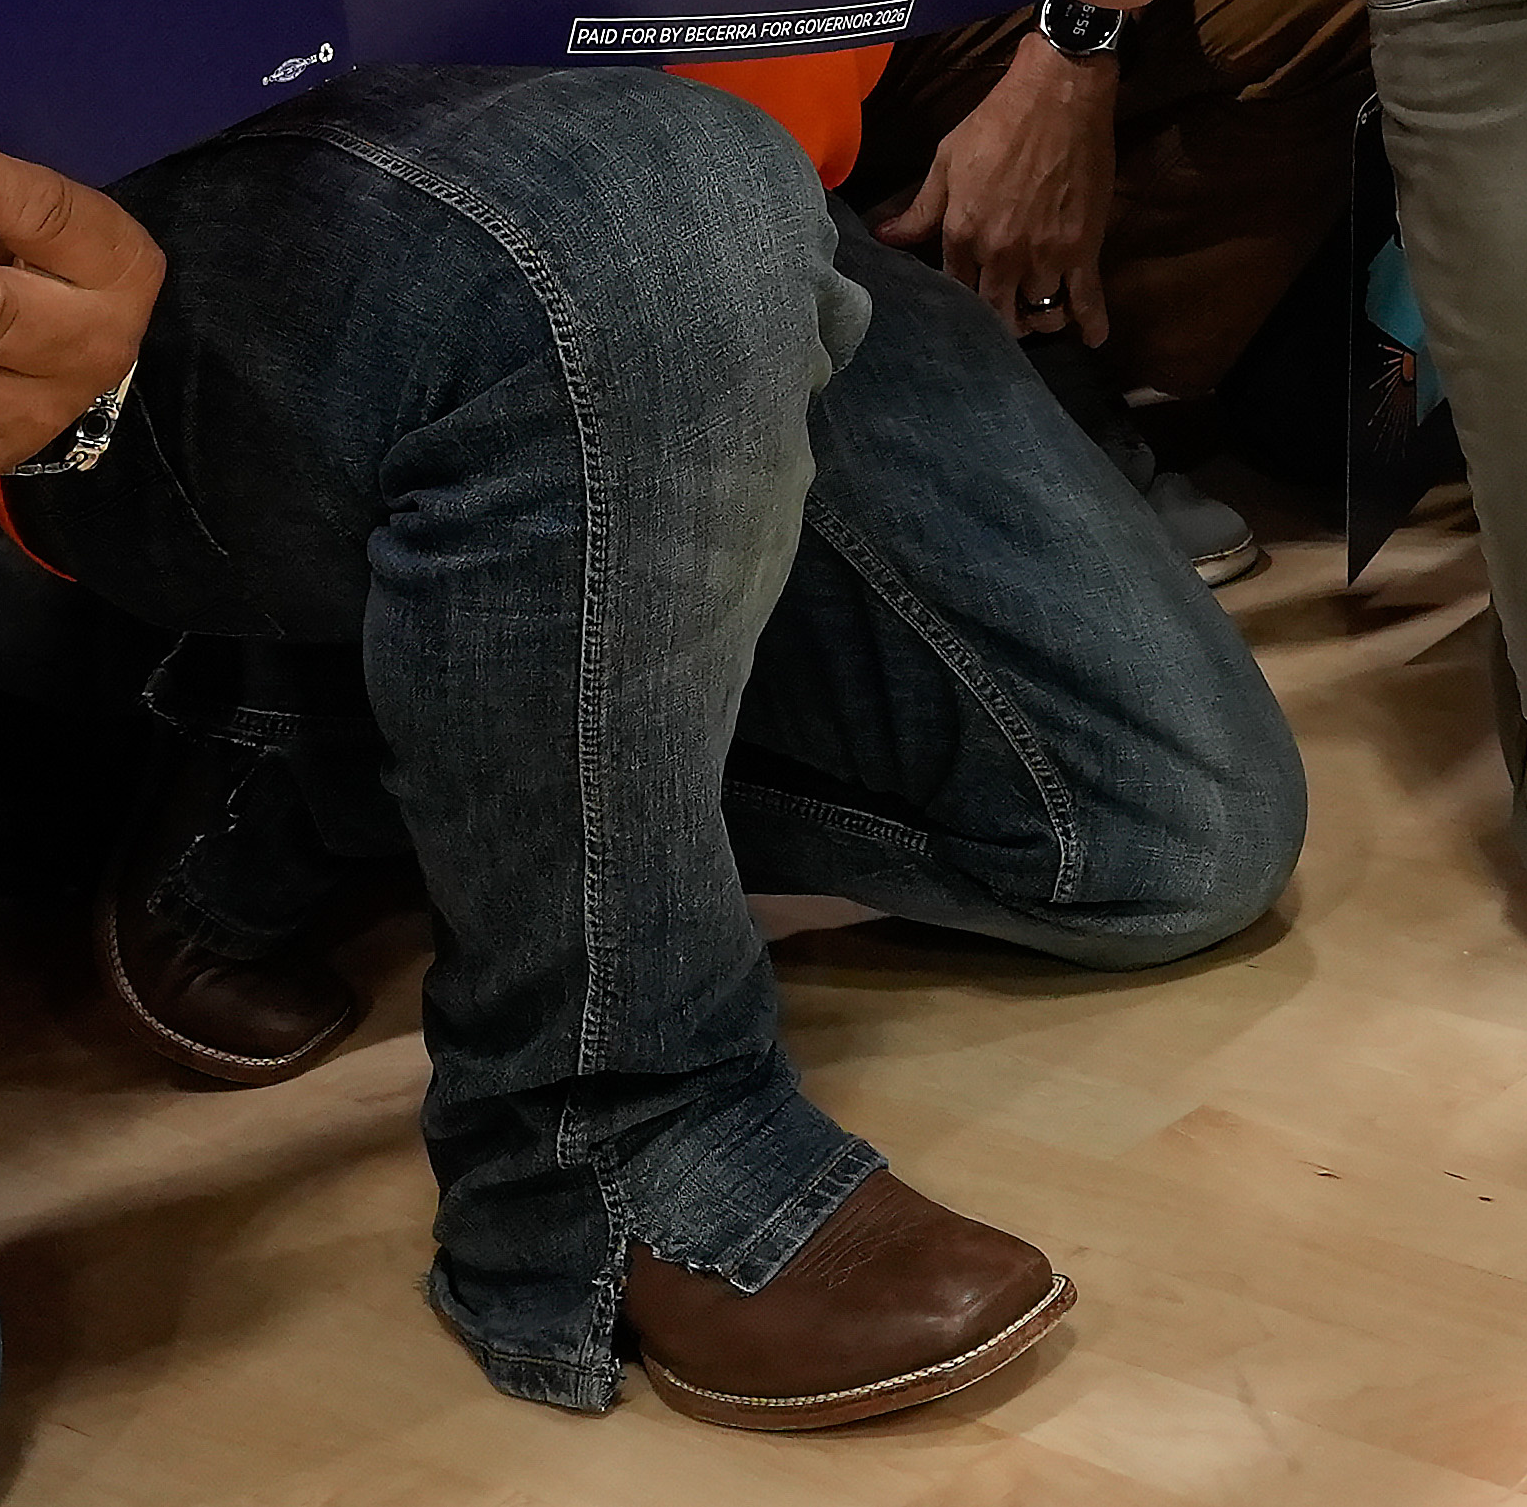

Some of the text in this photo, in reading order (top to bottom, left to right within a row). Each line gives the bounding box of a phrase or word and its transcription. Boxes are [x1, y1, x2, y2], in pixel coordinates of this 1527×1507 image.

[577, 7, 906, 45] PAID FOR BY BECERRA FOR GOVERNOR 2026
